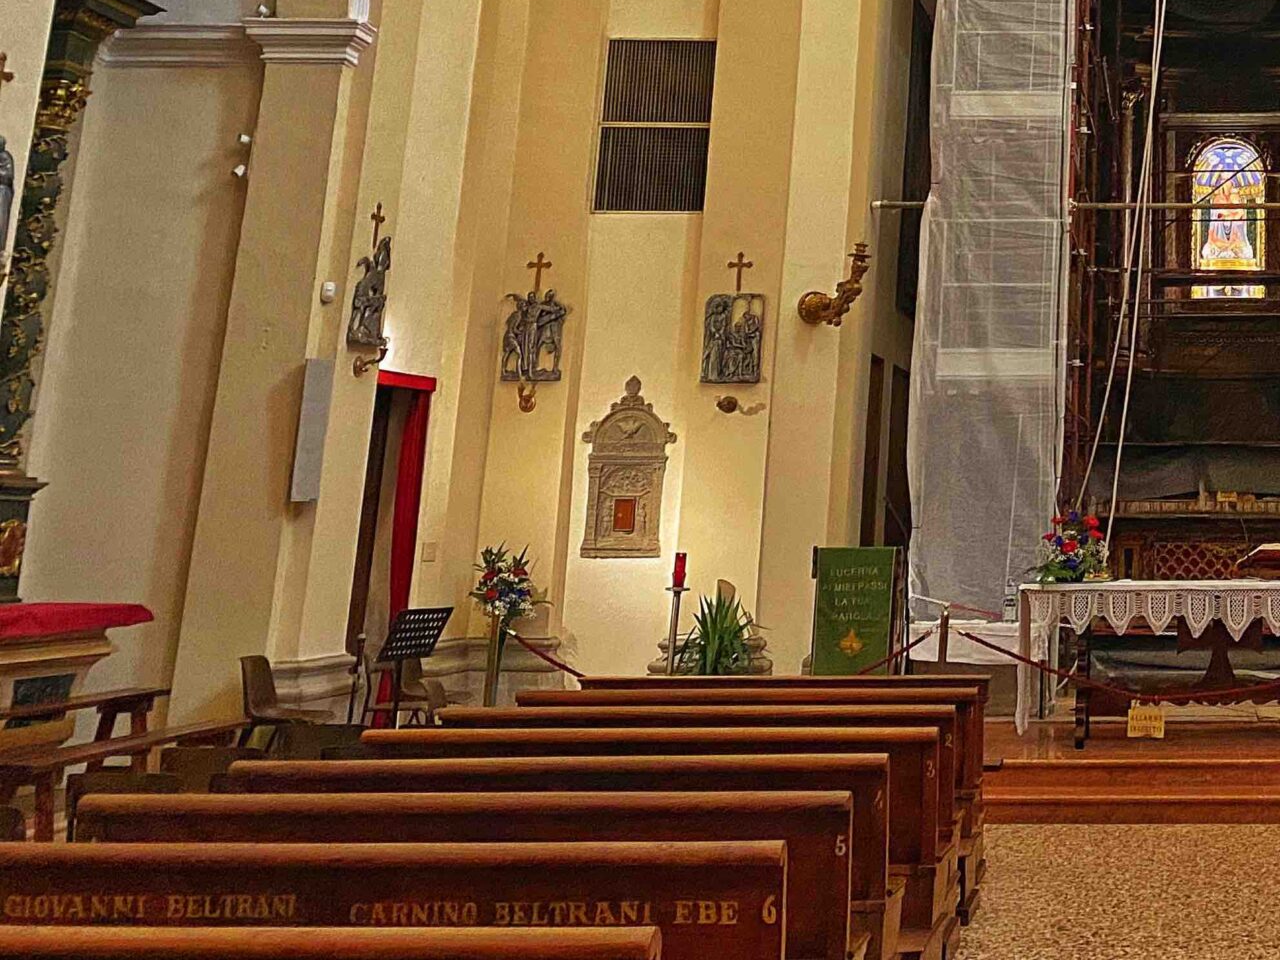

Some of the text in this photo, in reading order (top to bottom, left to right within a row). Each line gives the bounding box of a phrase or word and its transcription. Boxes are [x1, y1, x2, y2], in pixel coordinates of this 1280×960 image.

[834, 834, 847, 856] 5
[3, 894, 147, 919] GIOVANNI
[673, 900, 739, 925] EBE
[761, 894, 777, 925] 6
